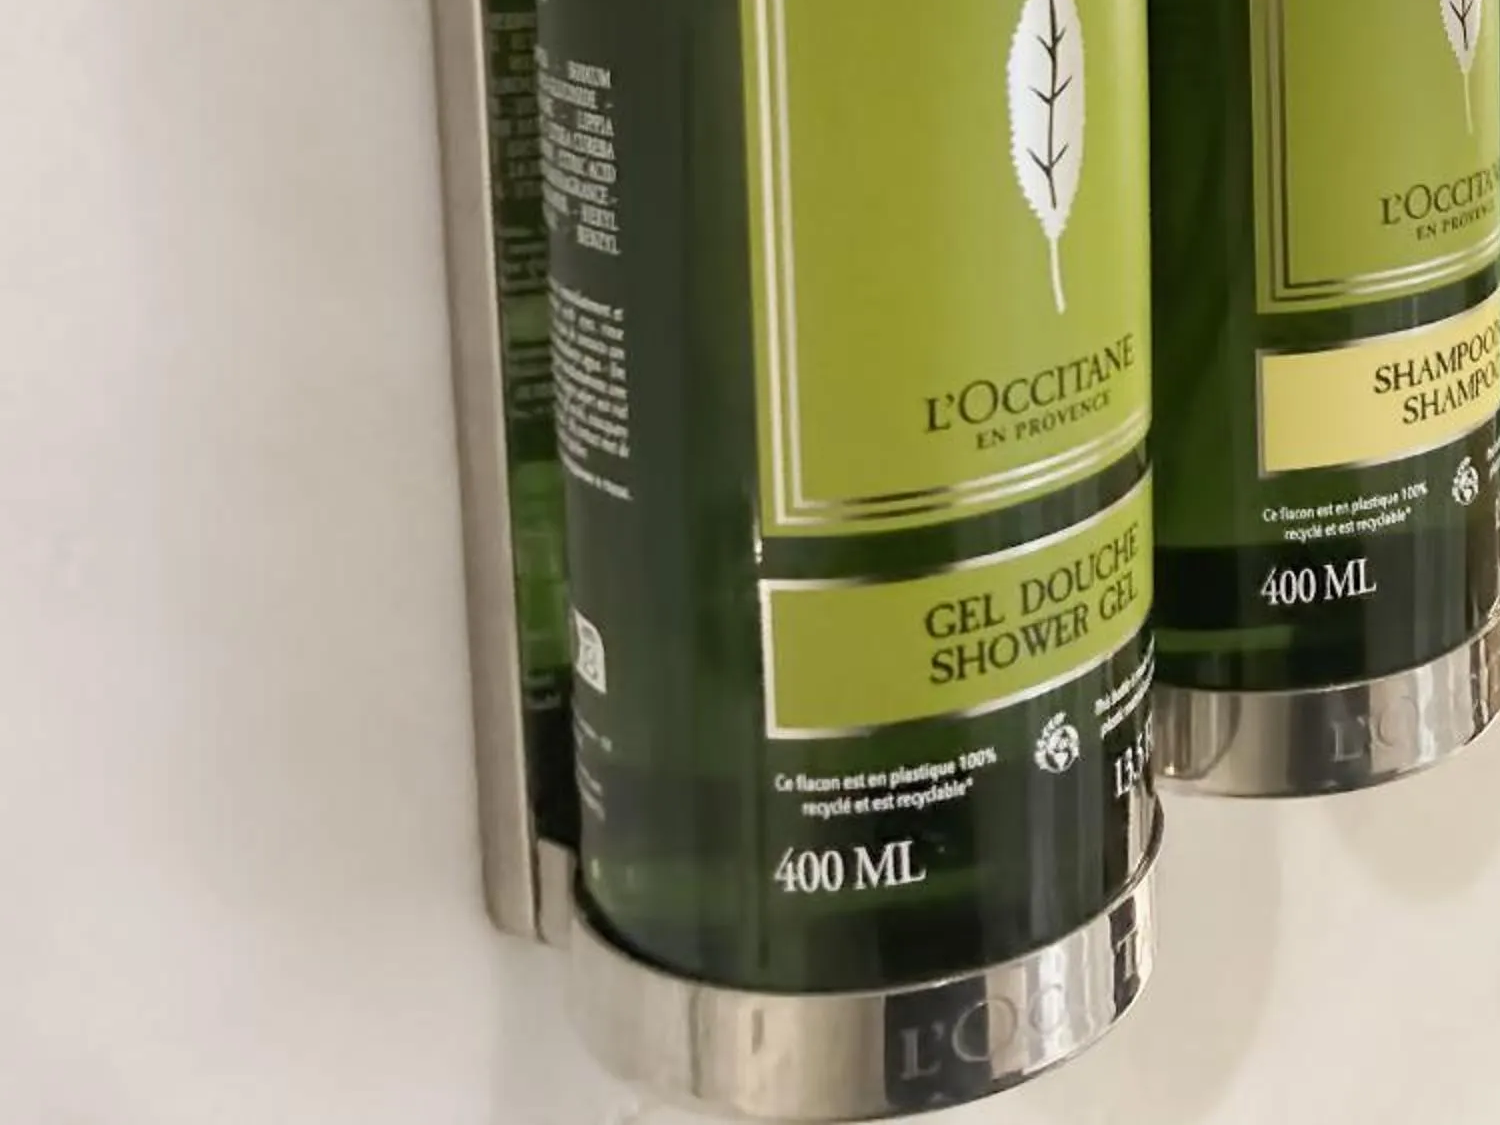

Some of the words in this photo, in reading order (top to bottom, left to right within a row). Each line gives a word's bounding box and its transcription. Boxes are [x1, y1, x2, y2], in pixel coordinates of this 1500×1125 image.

[1416, 222, 1437, 241] EN
[925, 332, 1135, 434] L'OCCITANE
[976, 427, 1006, 451] EN
[1014, 391, 1113, 441] PROVENCE
[1262, 508, 1278, 522] Ce
[1279, 506, 1315, 521] flacon
[1316, 504, 1334, 518] est
[1351, 492, 1399, 516] plastique
[1324, 524, 1337, 537] et
[1338, 521, 1354, 535] est
[924, 594, 1006, 639] GEL
[1020, 521, 1141, 606] DOUCHE
[1259, 566, 1316, 607] 400
[1322, 557, 1378, 602] ML
[928, 601, 1090, 686] SHOWER
[1098, 571, 1139, 622] GEL
[774, 774, 794, 792] Ce
[796, 773, 841, 792] flacon
[842, 774, 865, 791] est
[866, 772, 887, 788] en
[889, 760, 956, 790] plastique
[959, 746, 998, 772] 100%
[801, 795, 851, 820] recyclé
[853, 798, 869, 813] et
[872, 793, 895, 811] est
[773, 845, 844, 893] 400
[853, 838, 927, 890] ML
